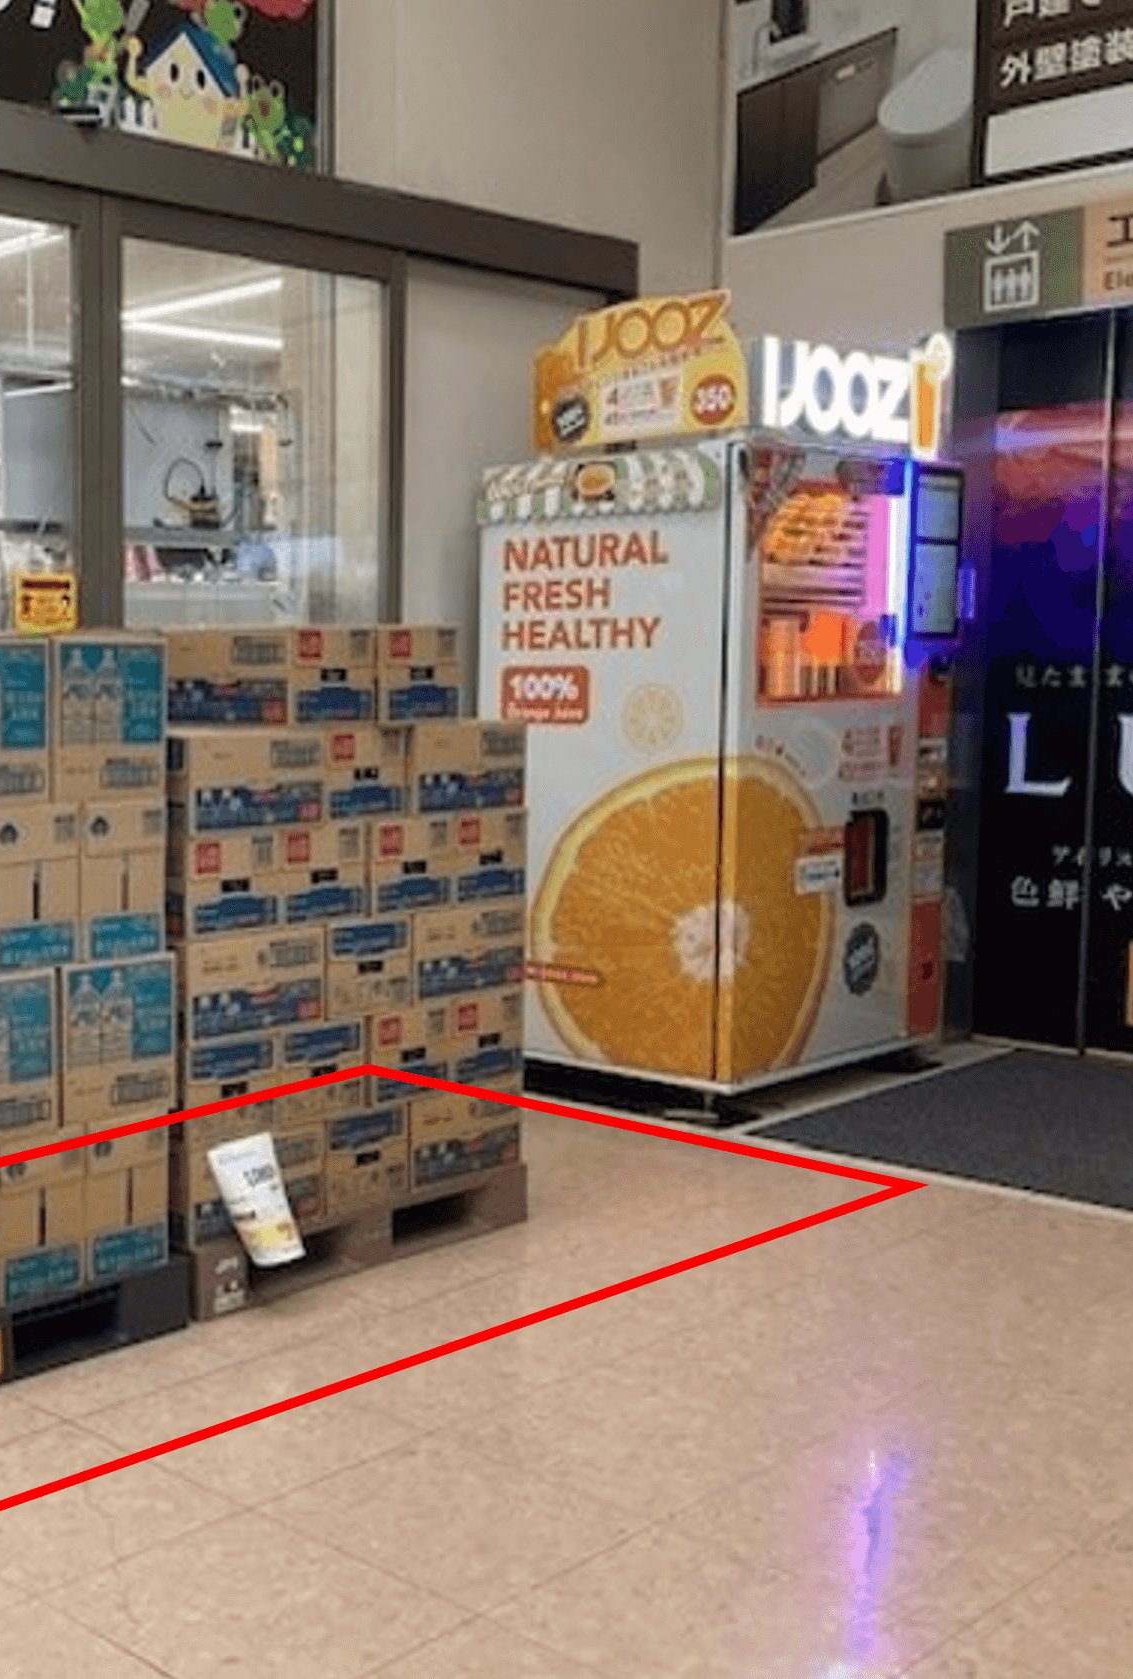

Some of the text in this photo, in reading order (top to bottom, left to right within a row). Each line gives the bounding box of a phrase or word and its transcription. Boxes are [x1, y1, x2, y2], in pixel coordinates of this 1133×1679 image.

[1002, 0, 1101, 27] 戸建
[503, 530, 669, 572] NATURAL
[503, 577, 611, 612] FRESH
[502, 616, 661, 651] HEALTHY
[509, 673, 579, 701] 100%
[1015, 664, 1133, 688] 見たまま
